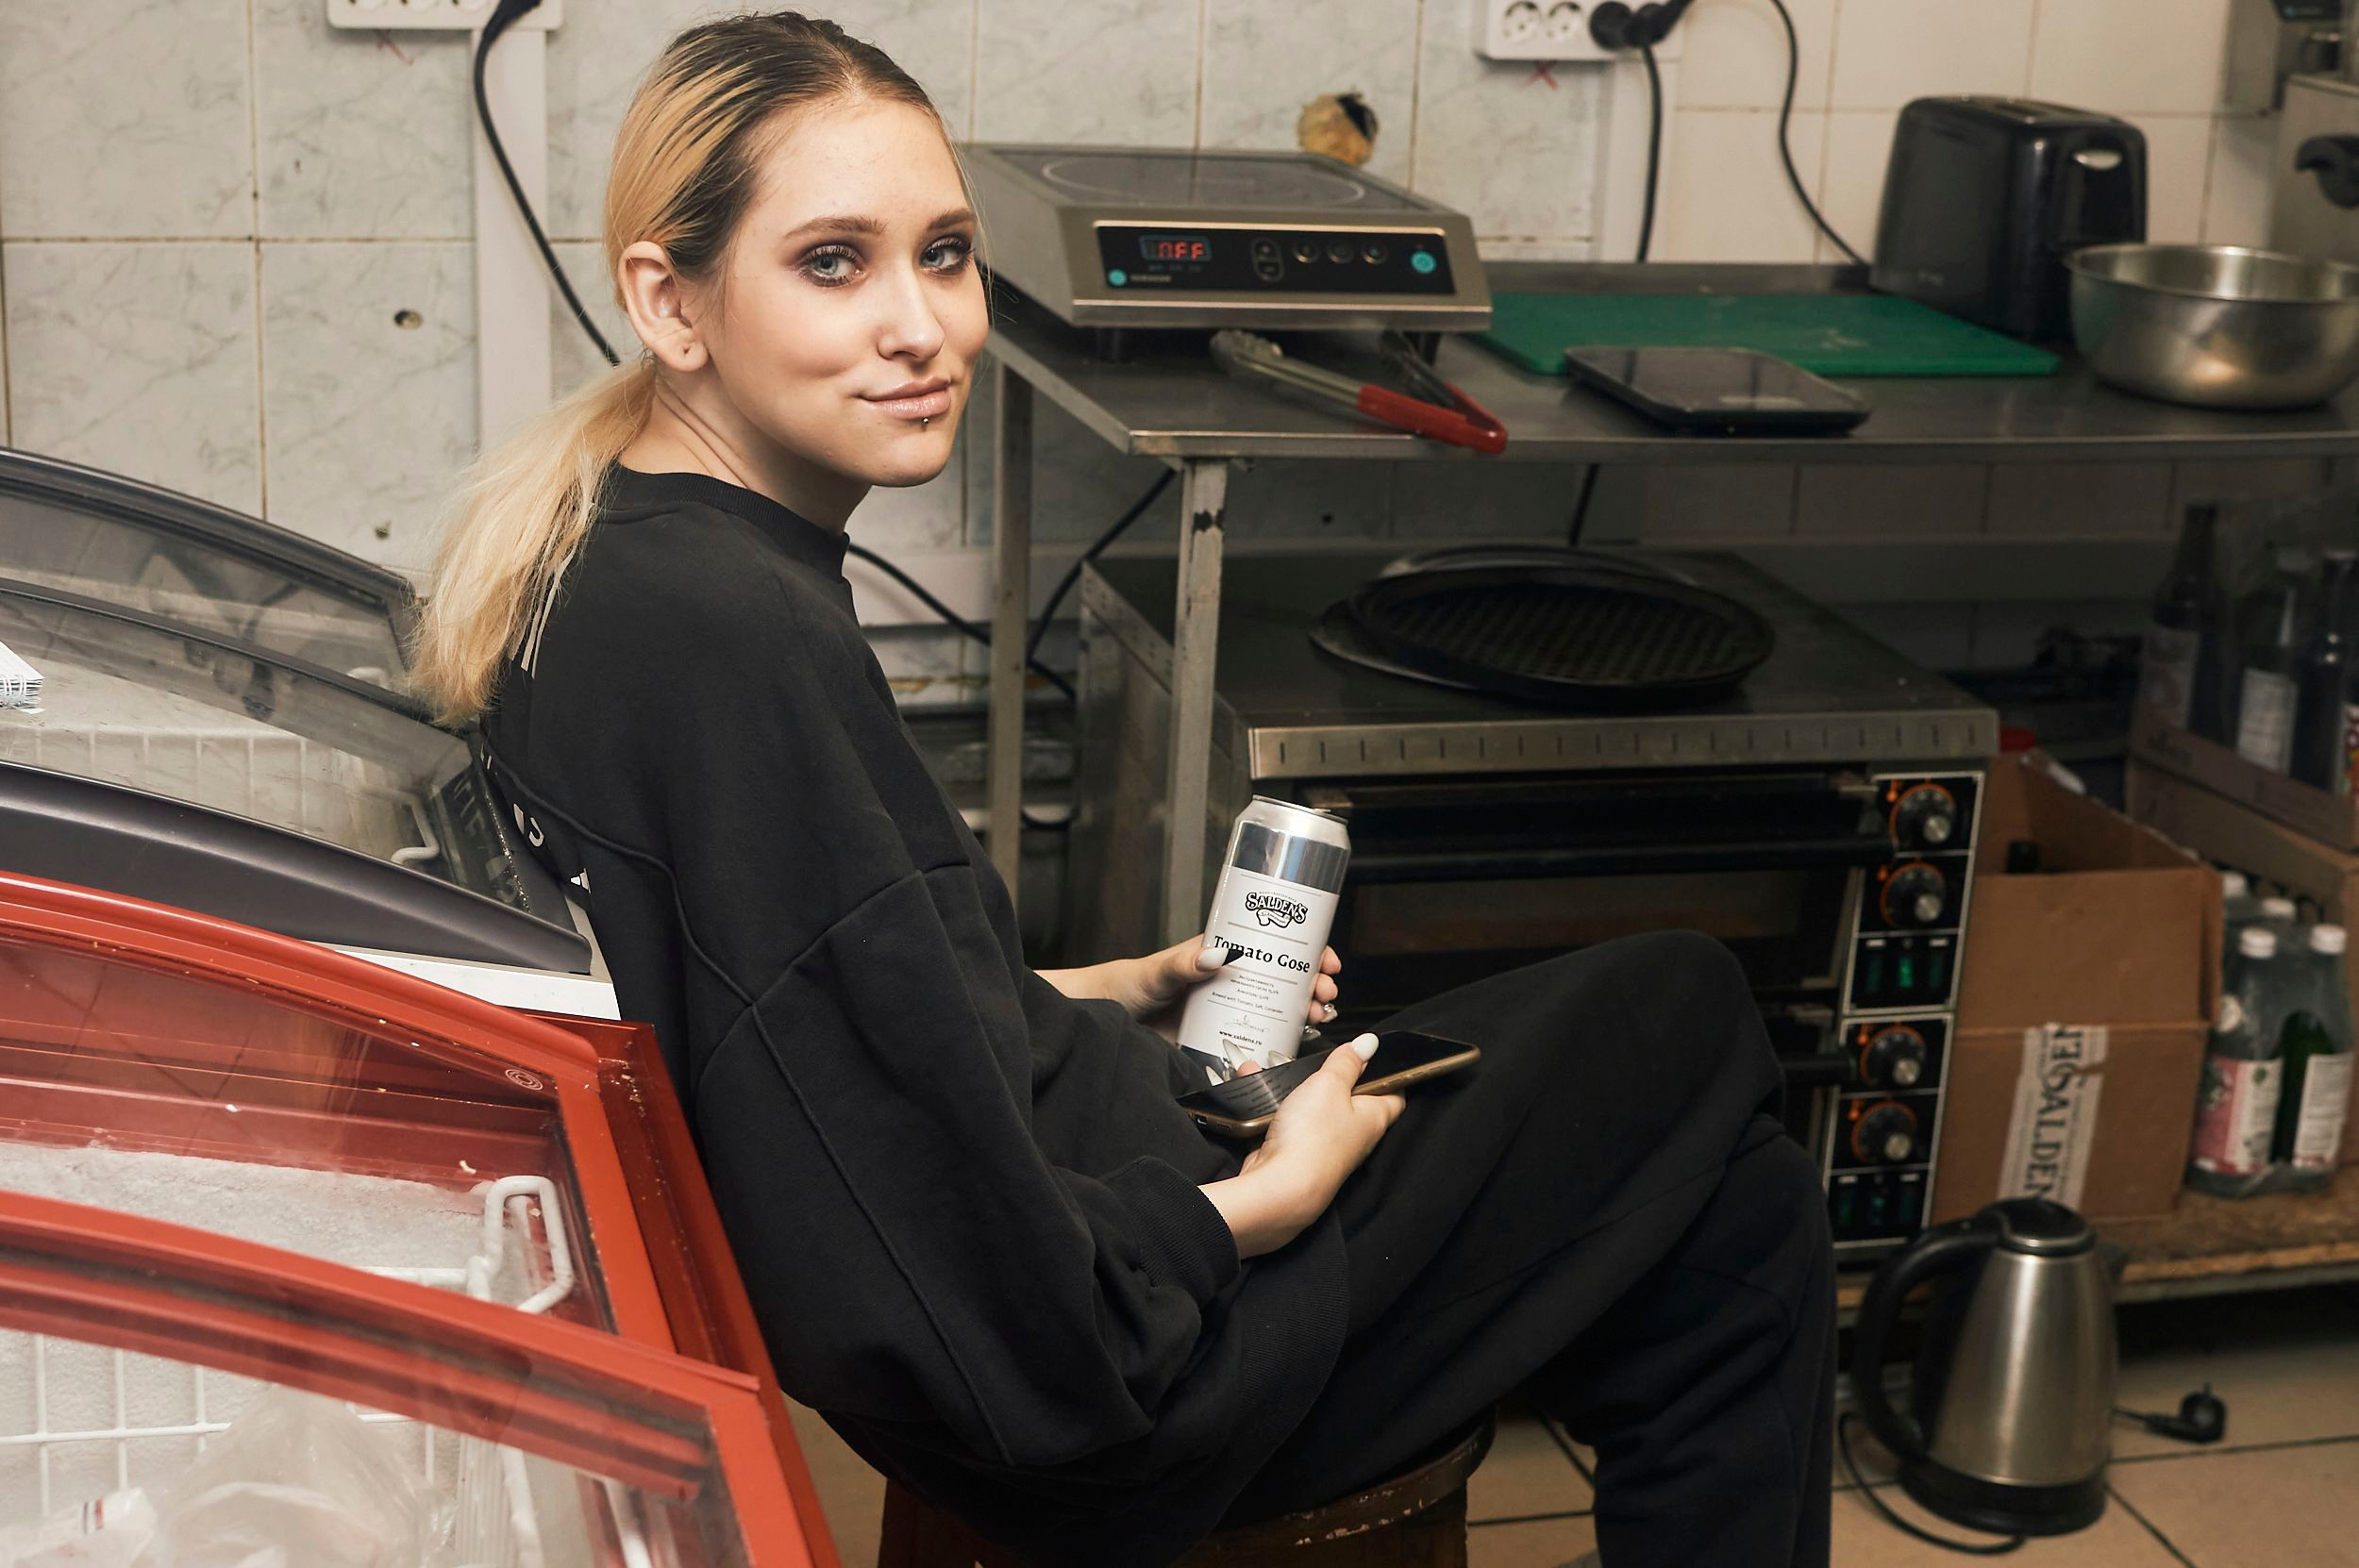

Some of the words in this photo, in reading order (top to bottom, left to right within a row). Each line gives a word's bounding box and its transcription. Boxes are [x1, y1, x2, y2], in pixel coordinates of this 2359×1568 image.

[1246, 892, 1308, 924] SALDEN'S
[1214, 935, 1273, 962] Tomato
[1277, 954, 1311, 973] Gose
